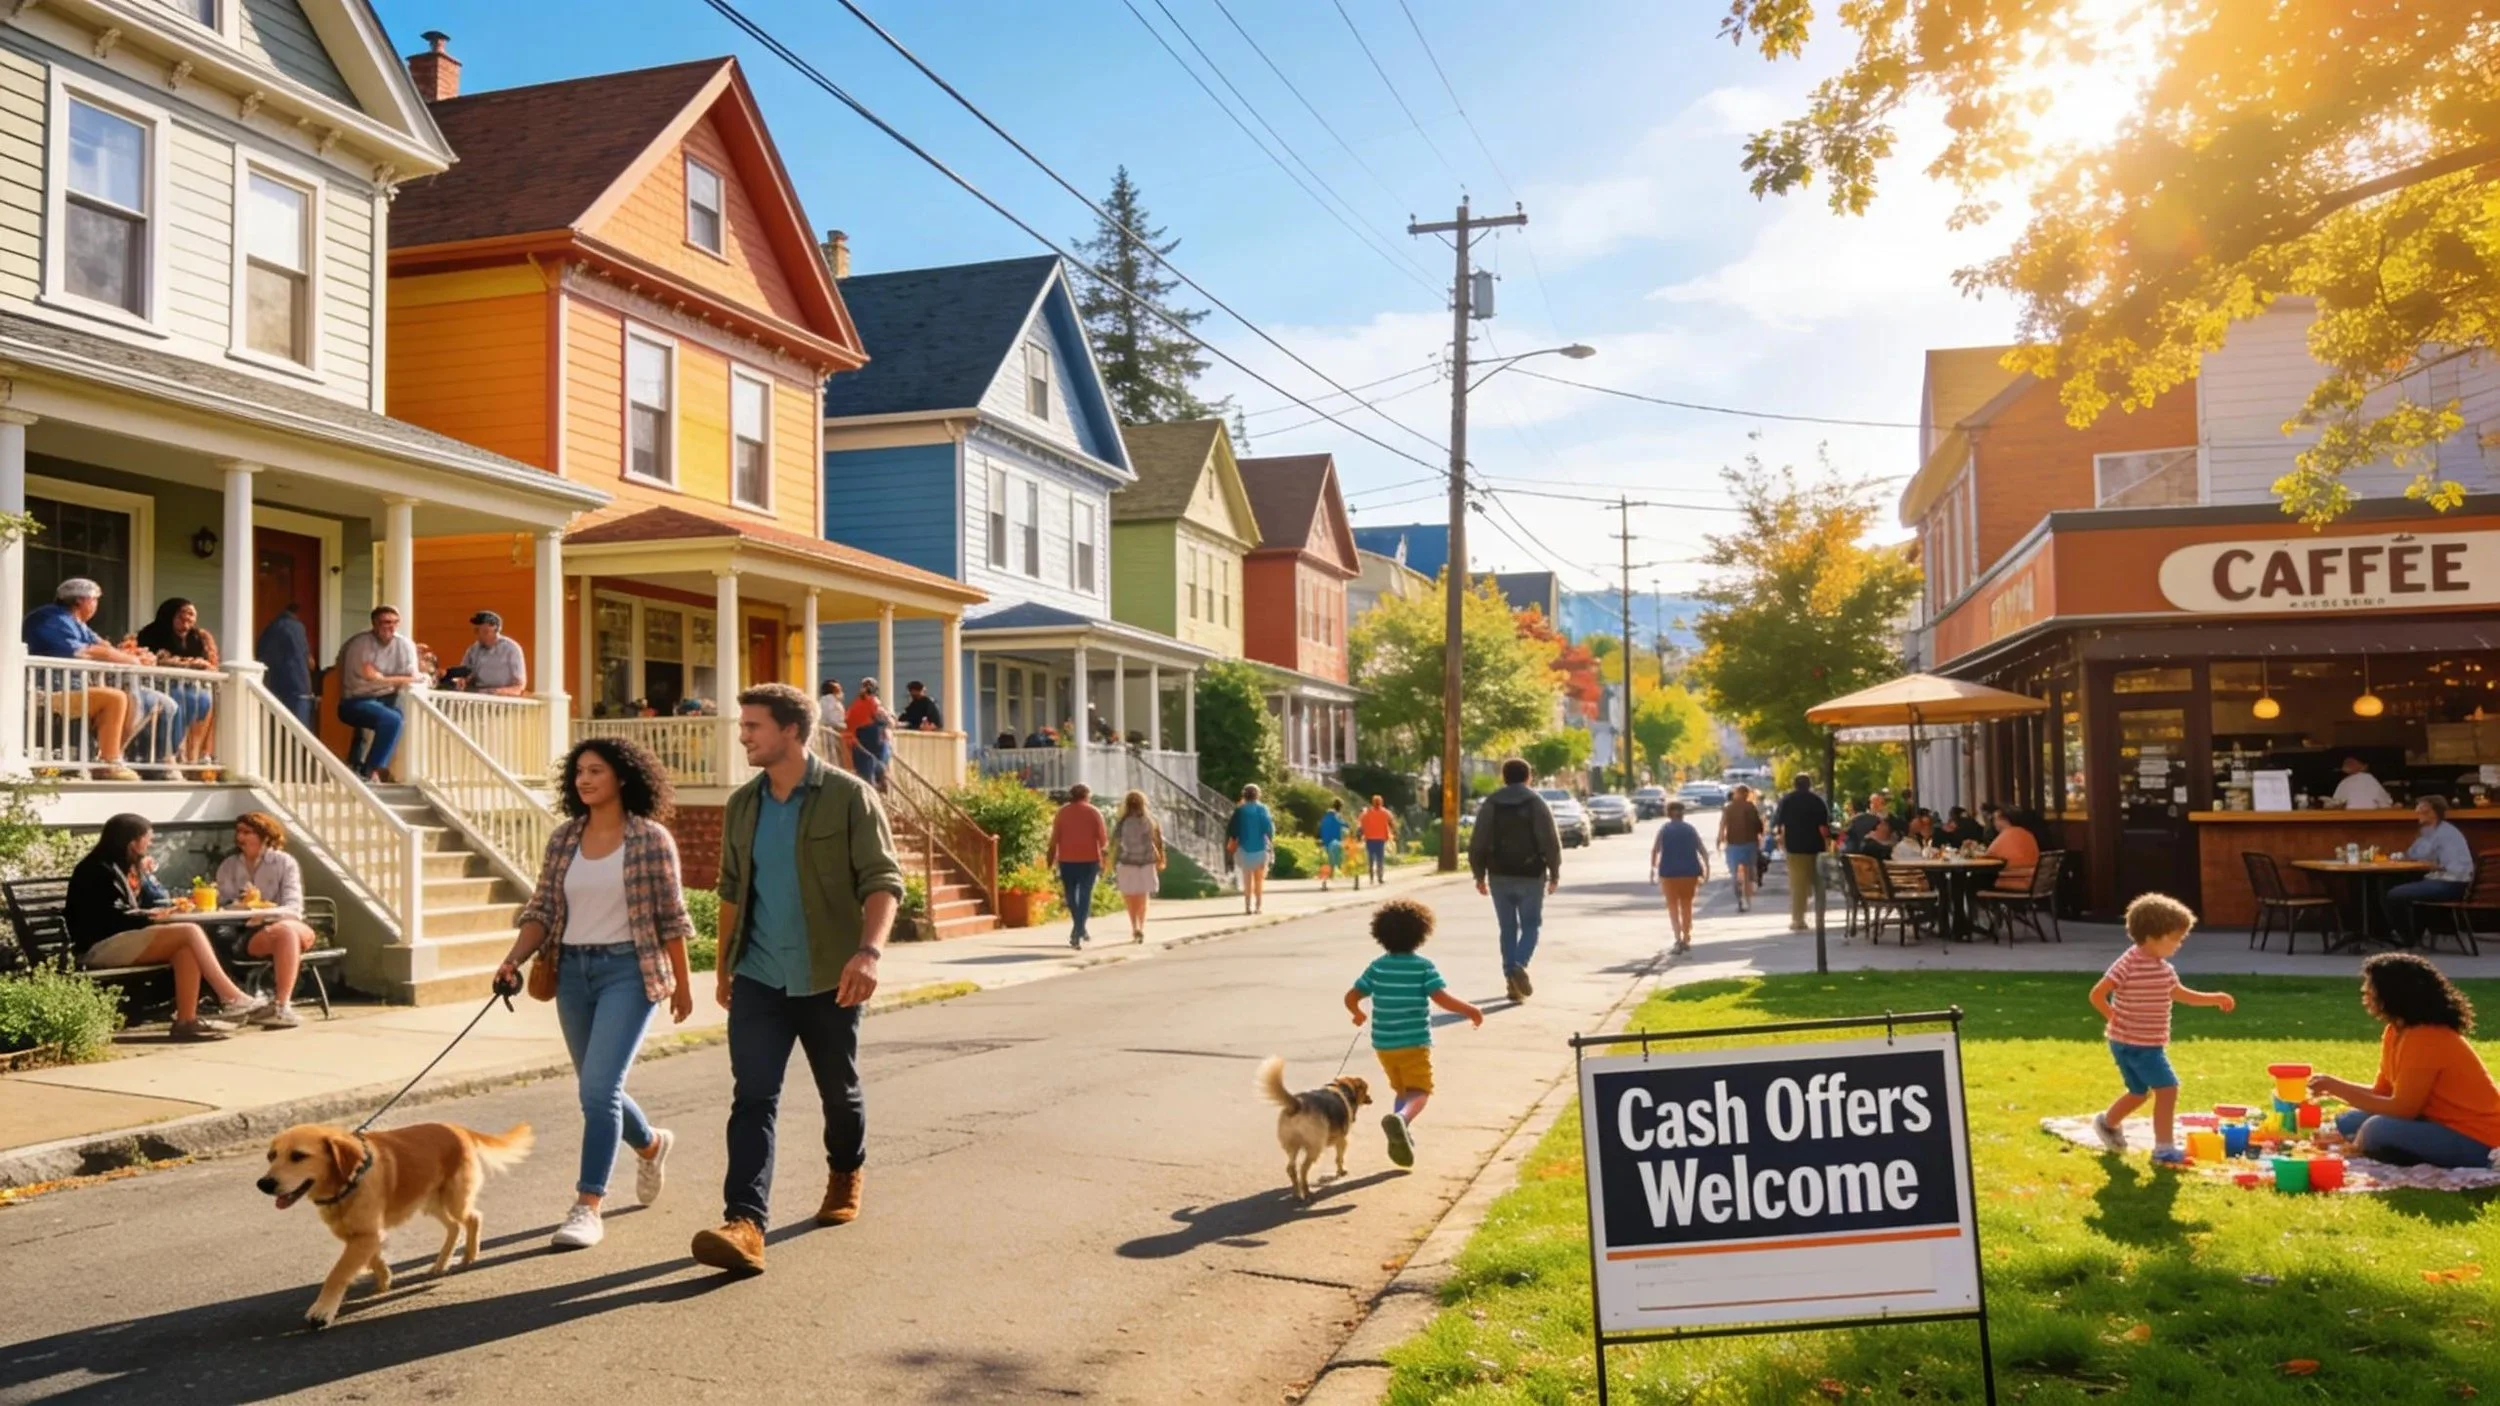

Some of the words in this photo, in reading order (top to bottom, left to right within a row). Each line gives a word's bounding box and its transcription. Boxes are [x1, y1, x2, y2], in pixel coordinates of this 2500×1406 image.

[1617, 1079, 1750, 1151] Cash
[1765, 1071, 1932, 1142] Offers
[1637, 1154, 1919, 1228] Welcome
